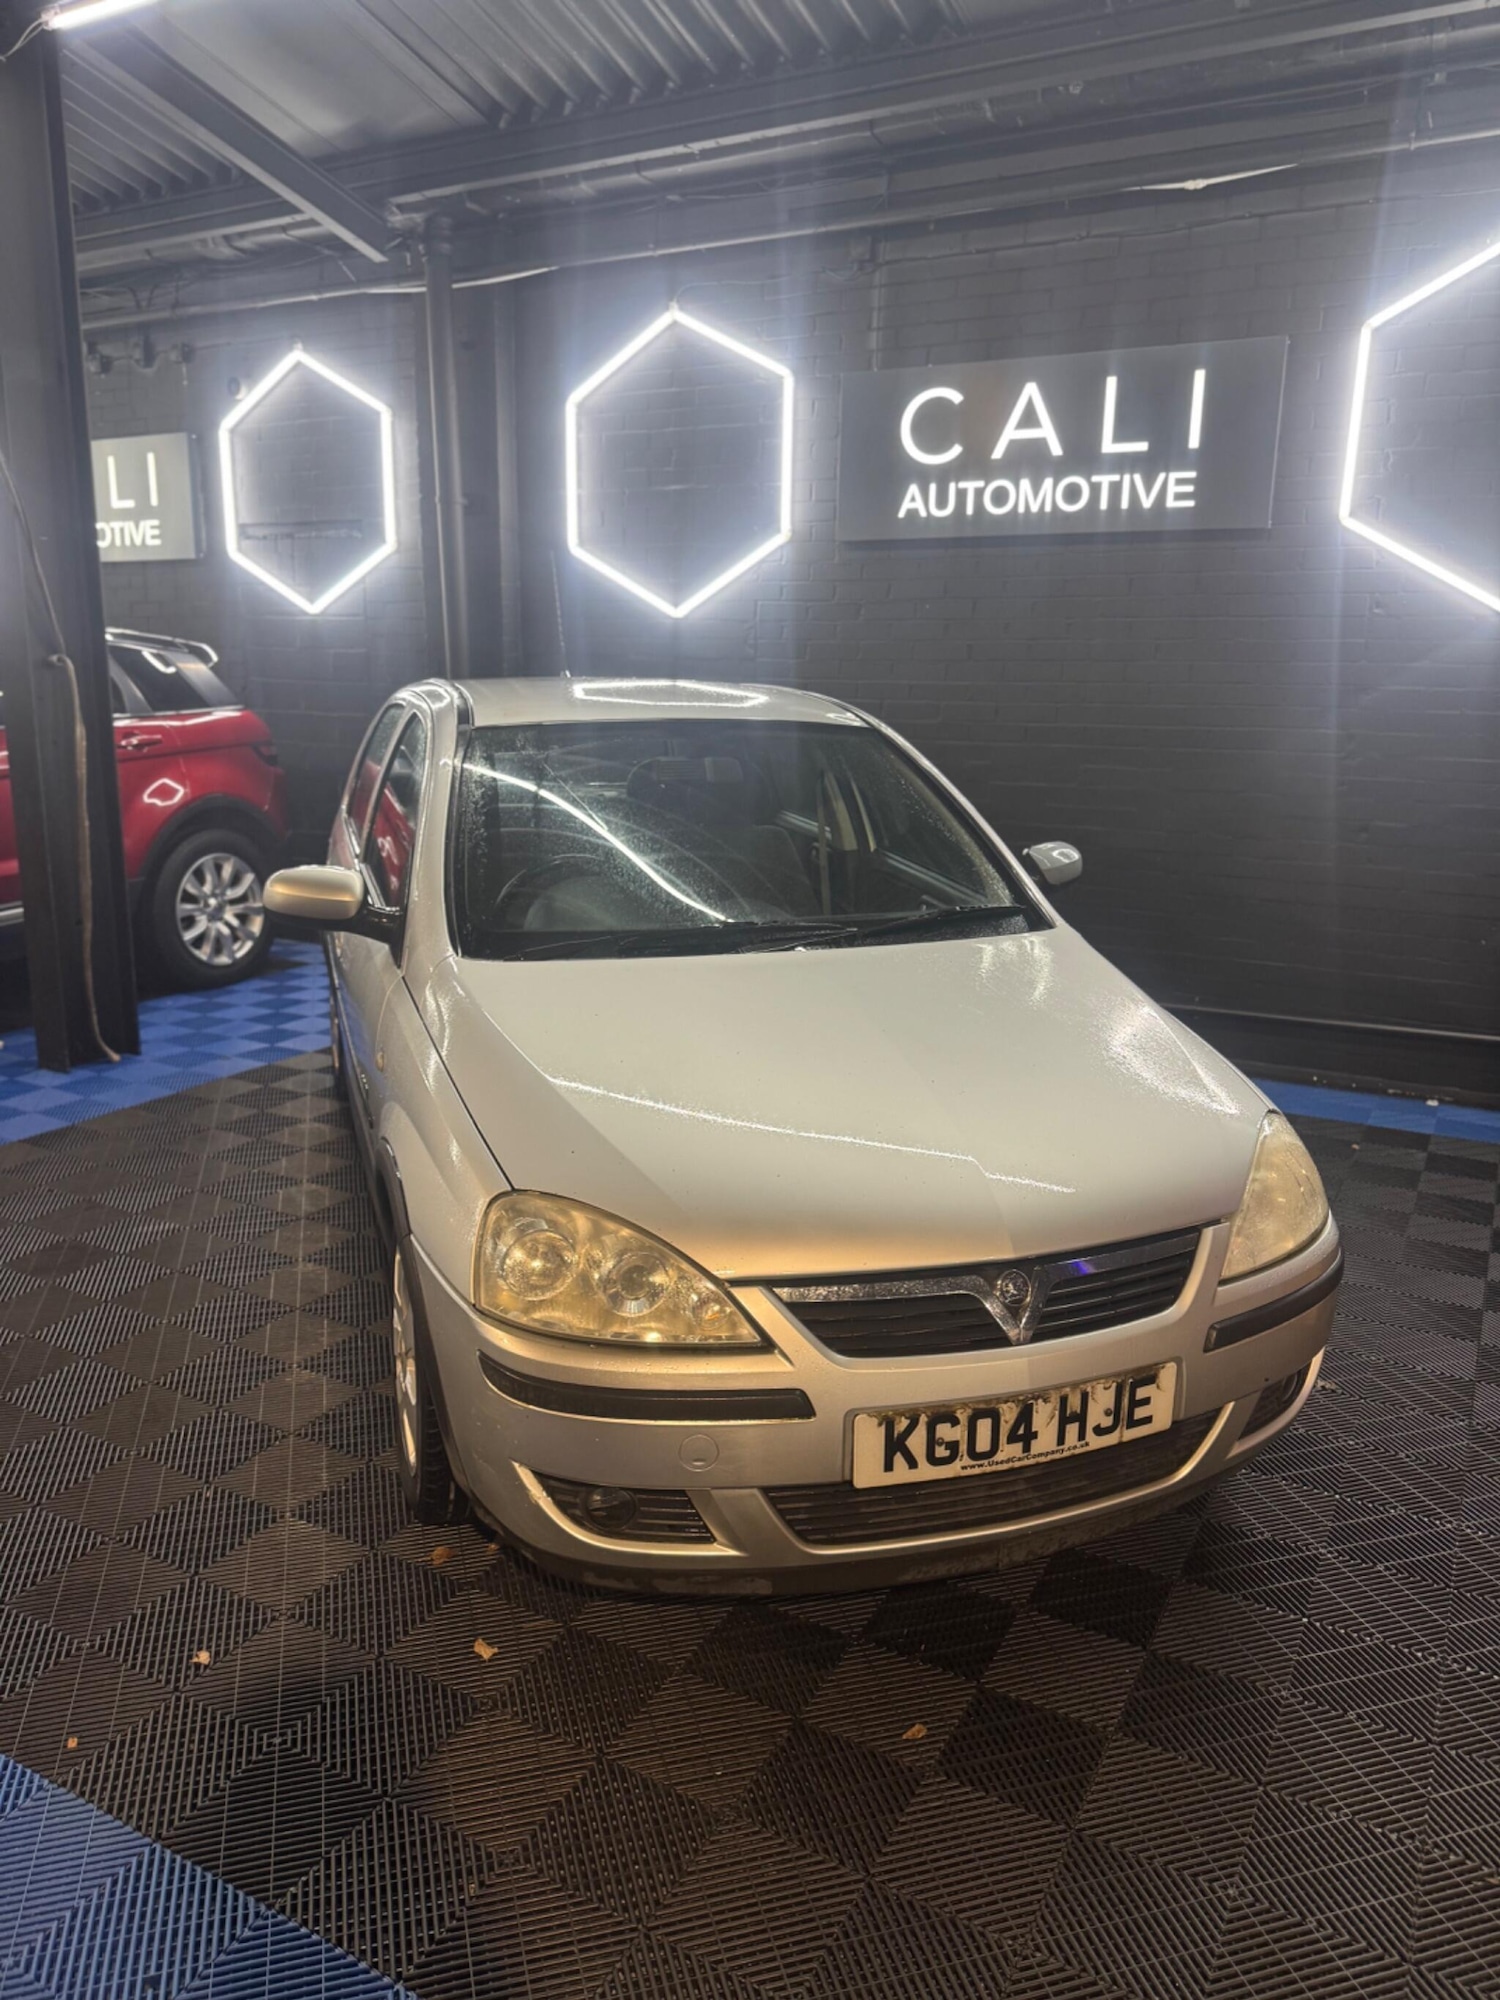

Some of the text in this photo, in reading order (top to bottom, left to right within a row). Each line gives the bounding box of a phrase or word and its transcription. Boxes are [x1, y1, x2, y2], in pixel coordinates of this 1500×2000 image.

[900, 369, 1206, 465] CALI
[898, 471, 1198, 518] AUTOMOTIVE
[883, 1375, 1158, 1473] KG04 HJE
[960, 1441, 1090, 1471] www.UsedCarCompany.co.uk
